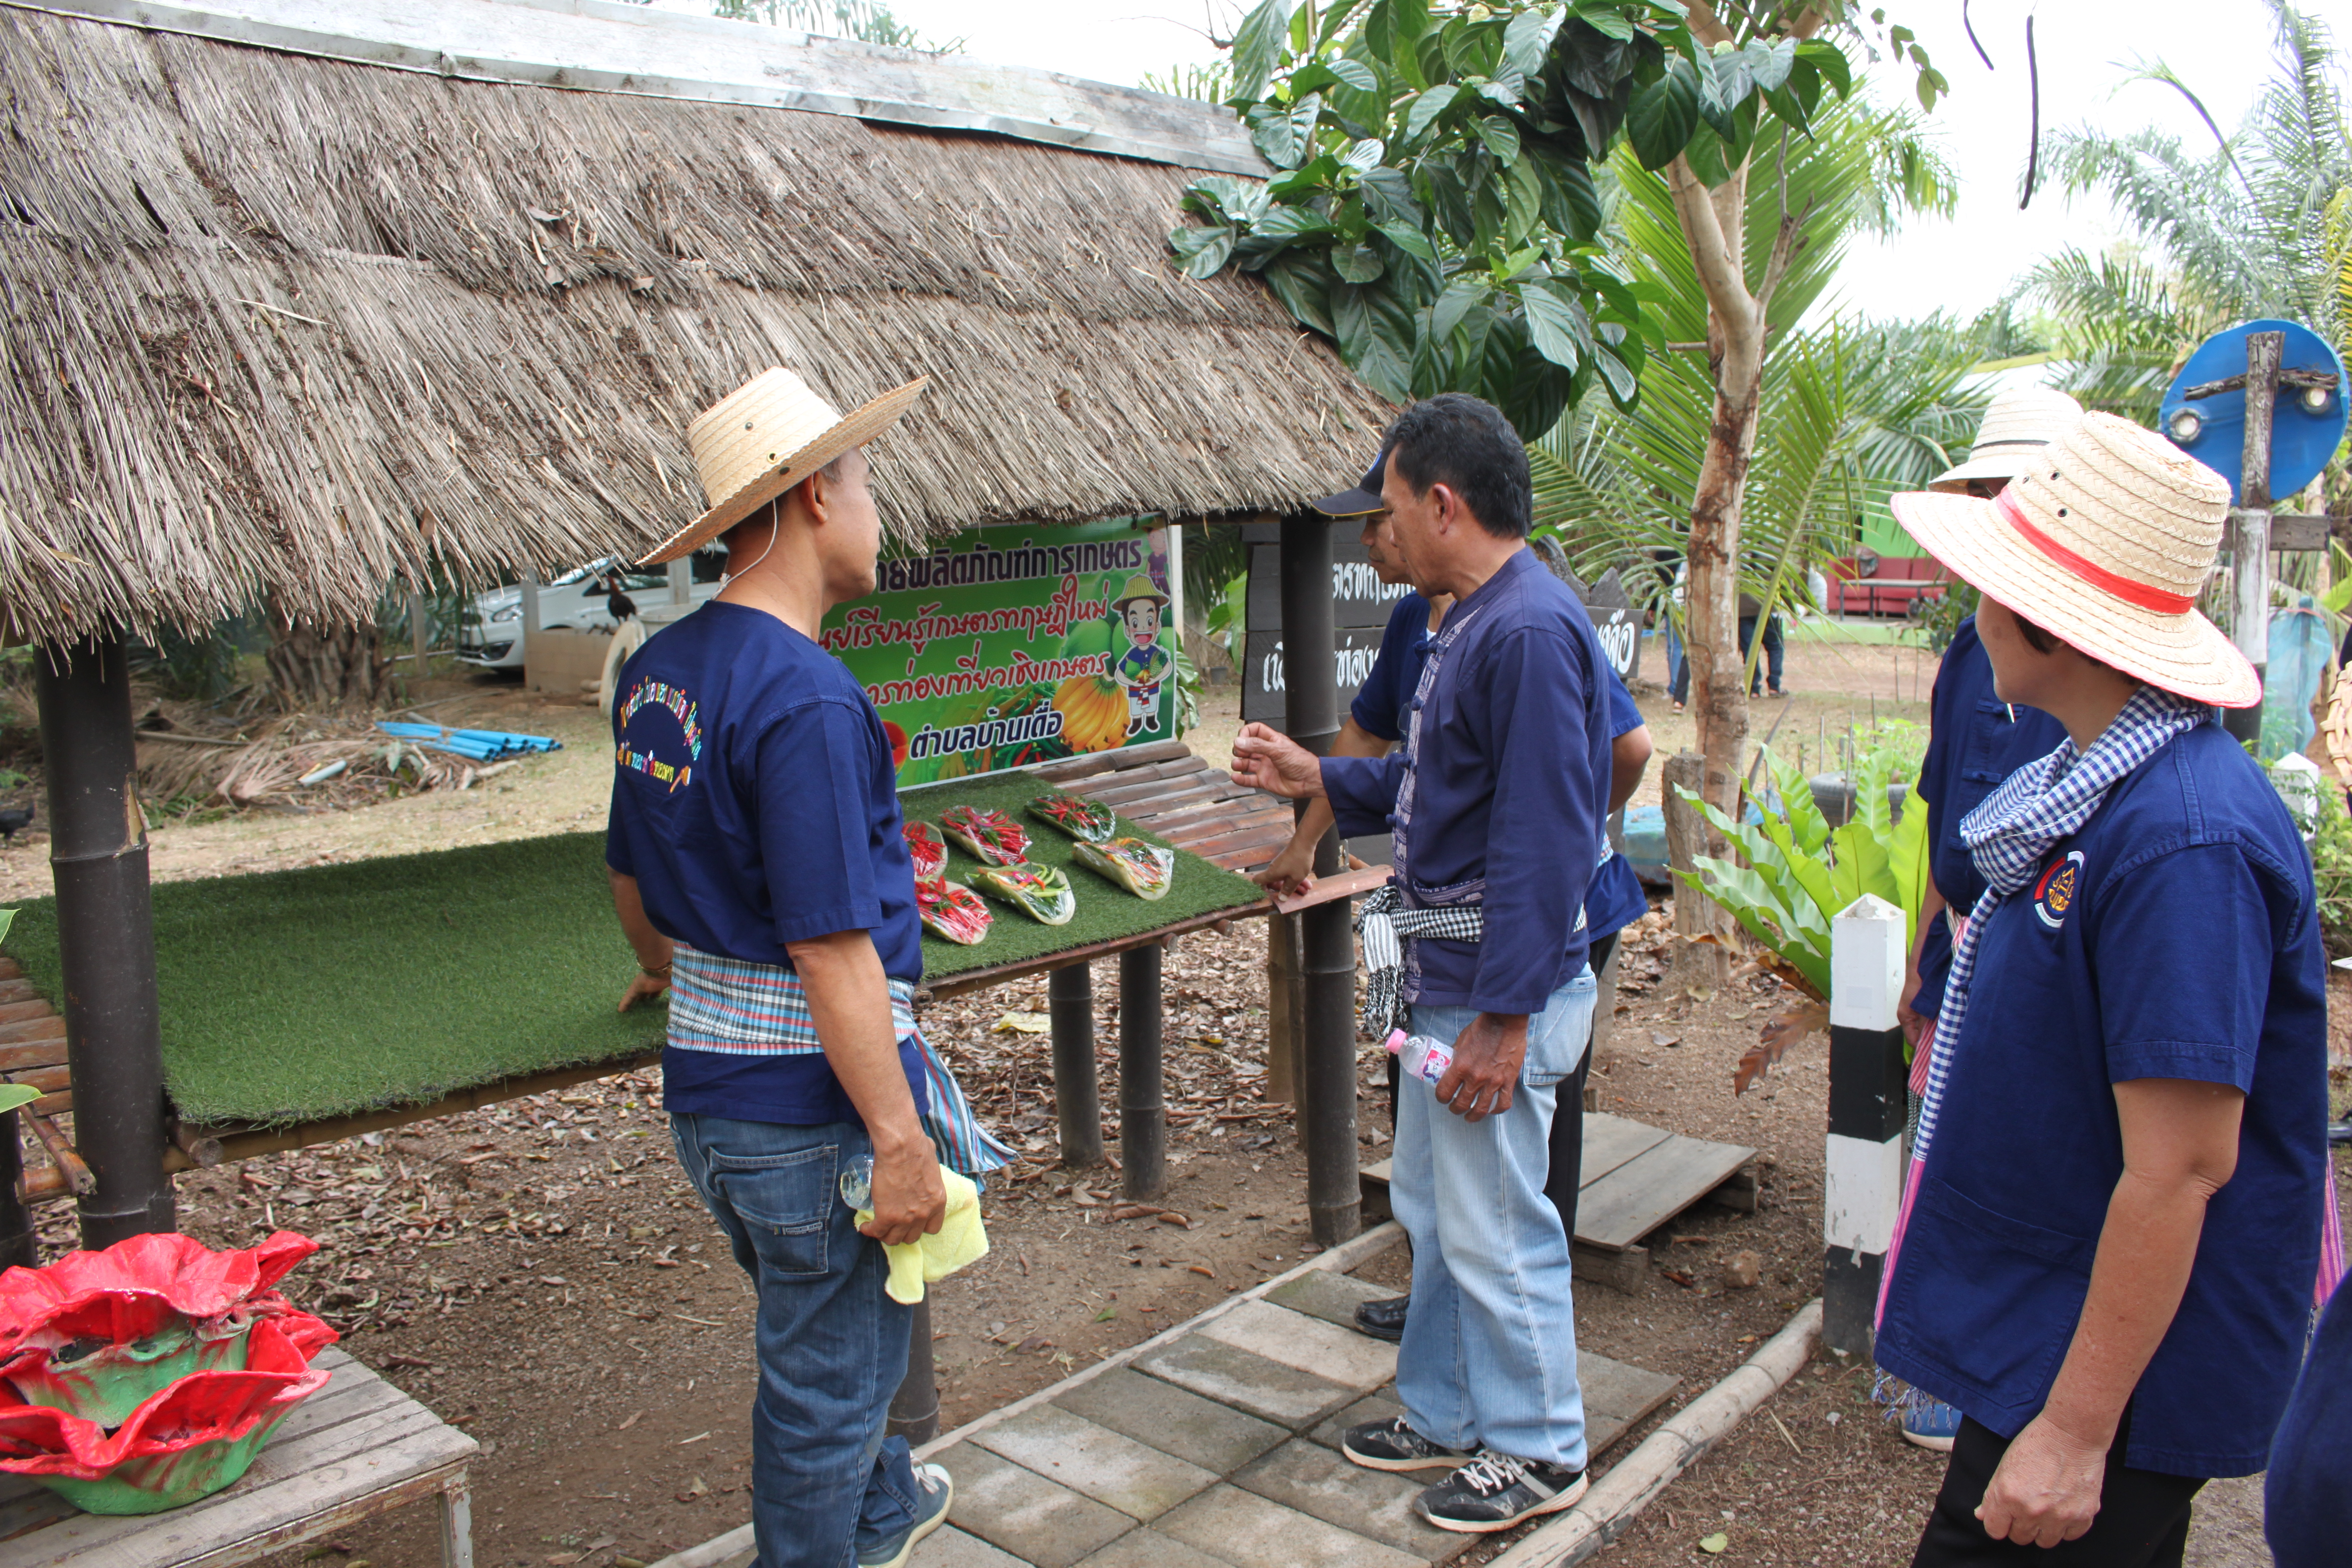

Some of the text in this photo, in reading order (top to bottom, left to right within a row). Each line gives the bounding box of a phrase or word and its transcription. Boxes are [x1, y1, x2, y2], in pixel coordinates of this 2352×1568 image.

[911, 701, 1063, 758] ตำบลบ้านเดื่อ
